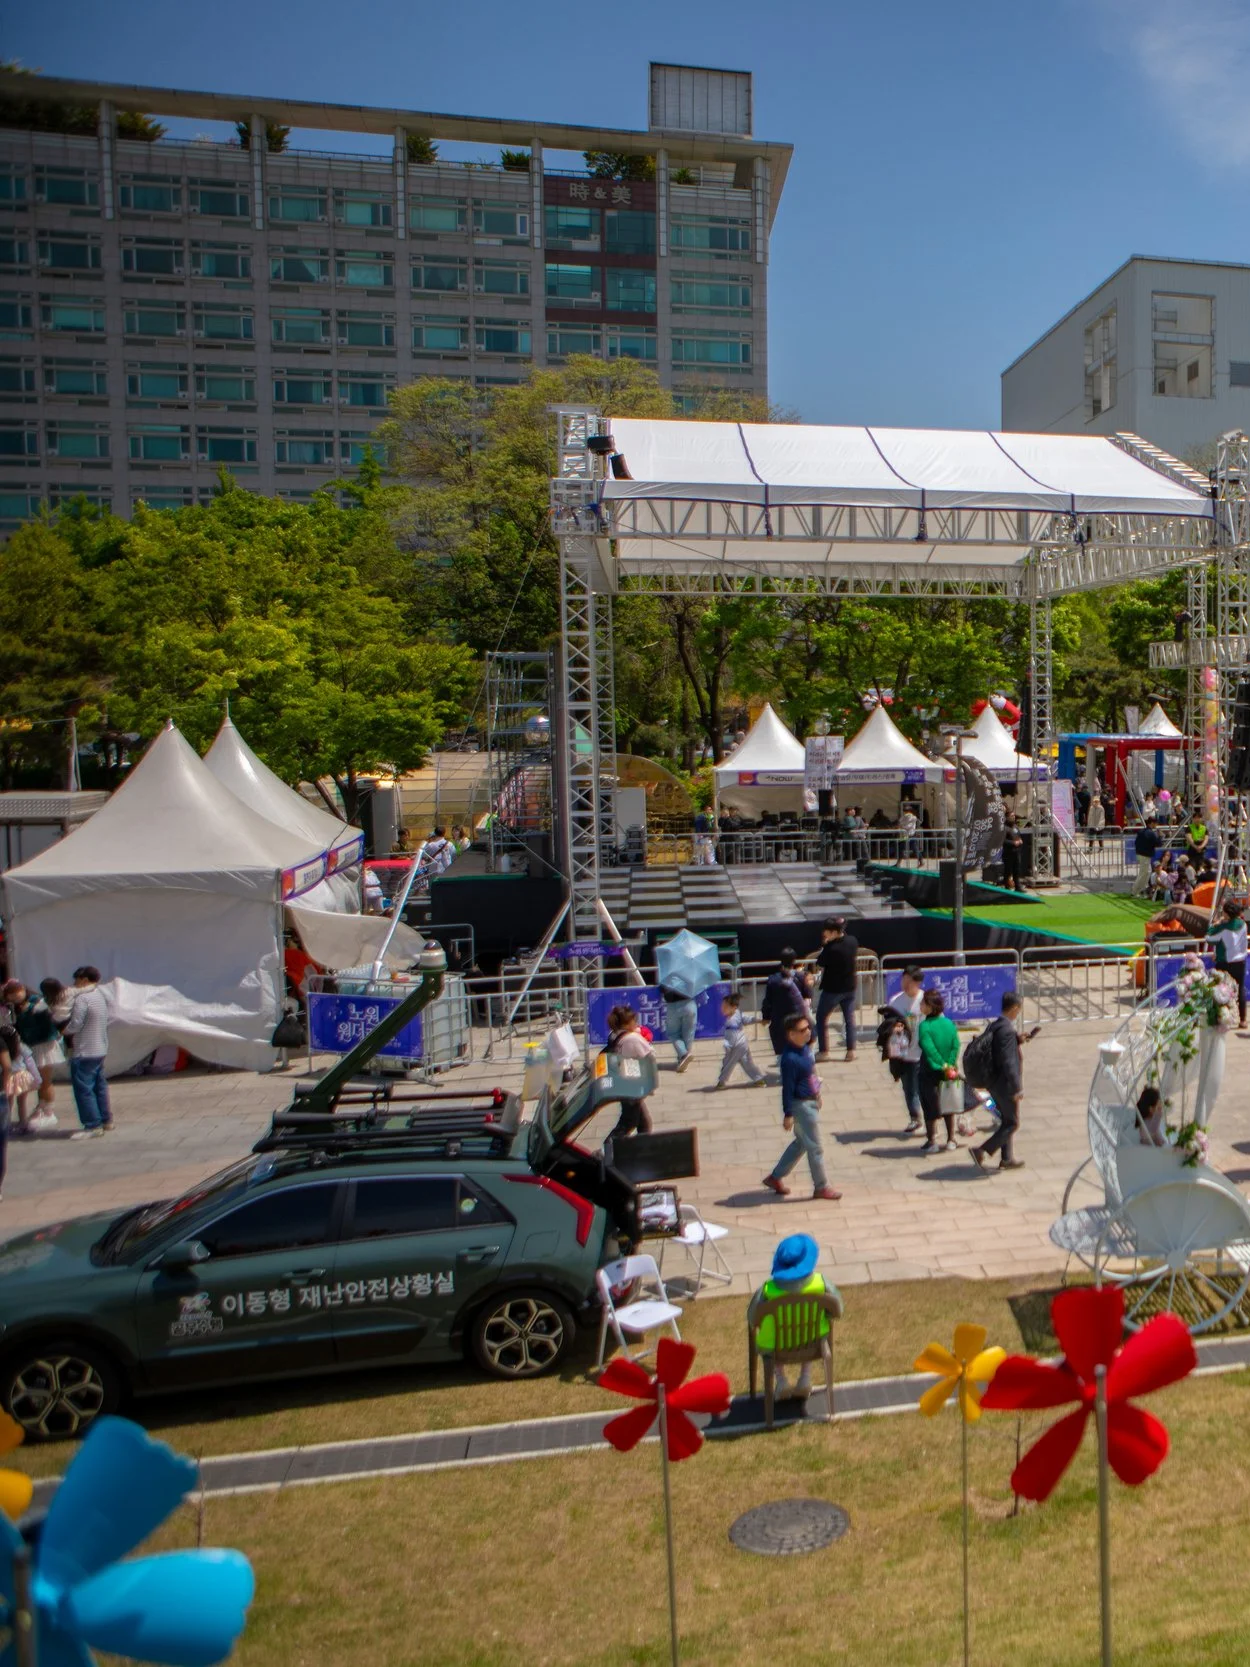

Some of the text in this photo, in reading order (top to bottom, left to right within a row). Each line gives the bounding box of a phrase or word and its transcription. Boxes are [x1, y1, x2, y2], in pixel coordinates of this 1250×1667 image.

[932, 974, 968, 994] 노원
[348, 1003, 380, 1026] 노원
[222, 1271, 455, 1317] 이동형 재난안전상황실
